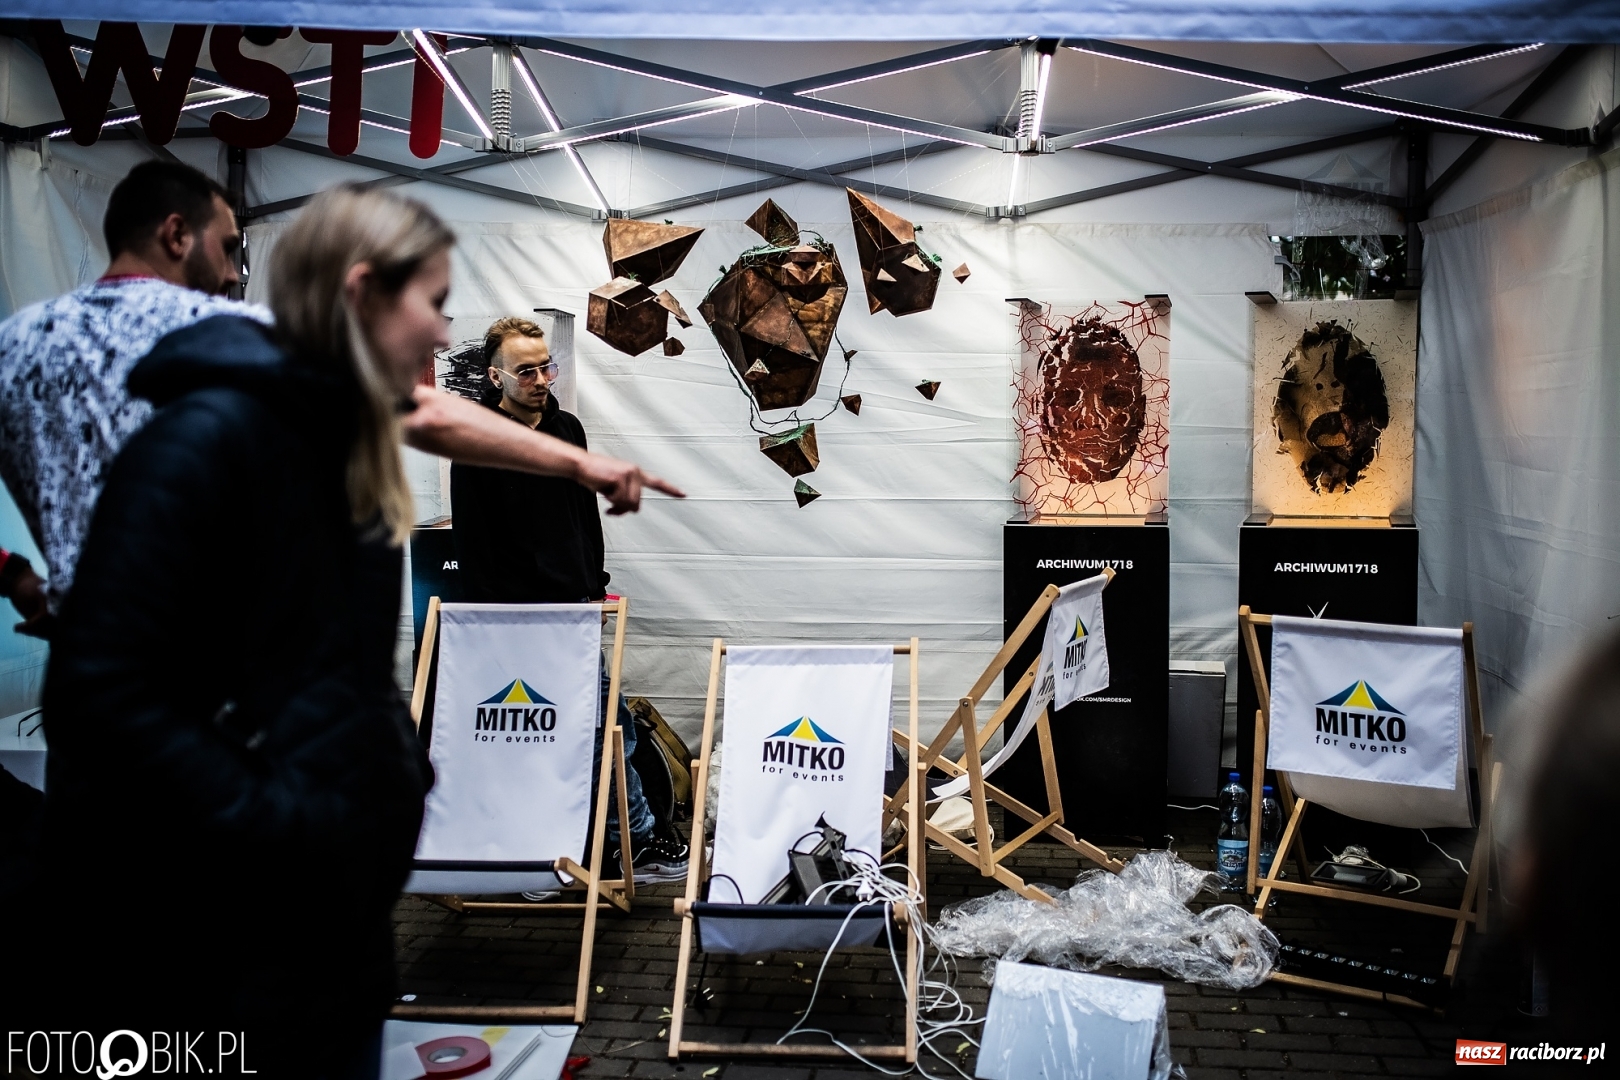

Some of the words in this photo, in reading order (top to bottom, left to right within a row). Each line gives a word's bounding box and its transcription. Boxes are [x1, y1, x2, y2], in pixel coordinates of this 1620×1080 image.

[31, 18, 448, 159] WSTI
[1036, 559, 1134, 570] ARCHIWUM1718
[1273, 562, 1379, 574] ARCHIWUM1718
[475, 707, 557, 732] MITKO
[1315, 707, 1407, 743] MITKO
[474, 733, 496, 742] for
[505, 735, 556, 743] events
[1315, 735, 1339, 746] for
[1349, 742, 1407, 754] events
[762, 740, 845, 771] MITKO
[762, 765, 784, 774] for
[792, 772, 844, 782] events
